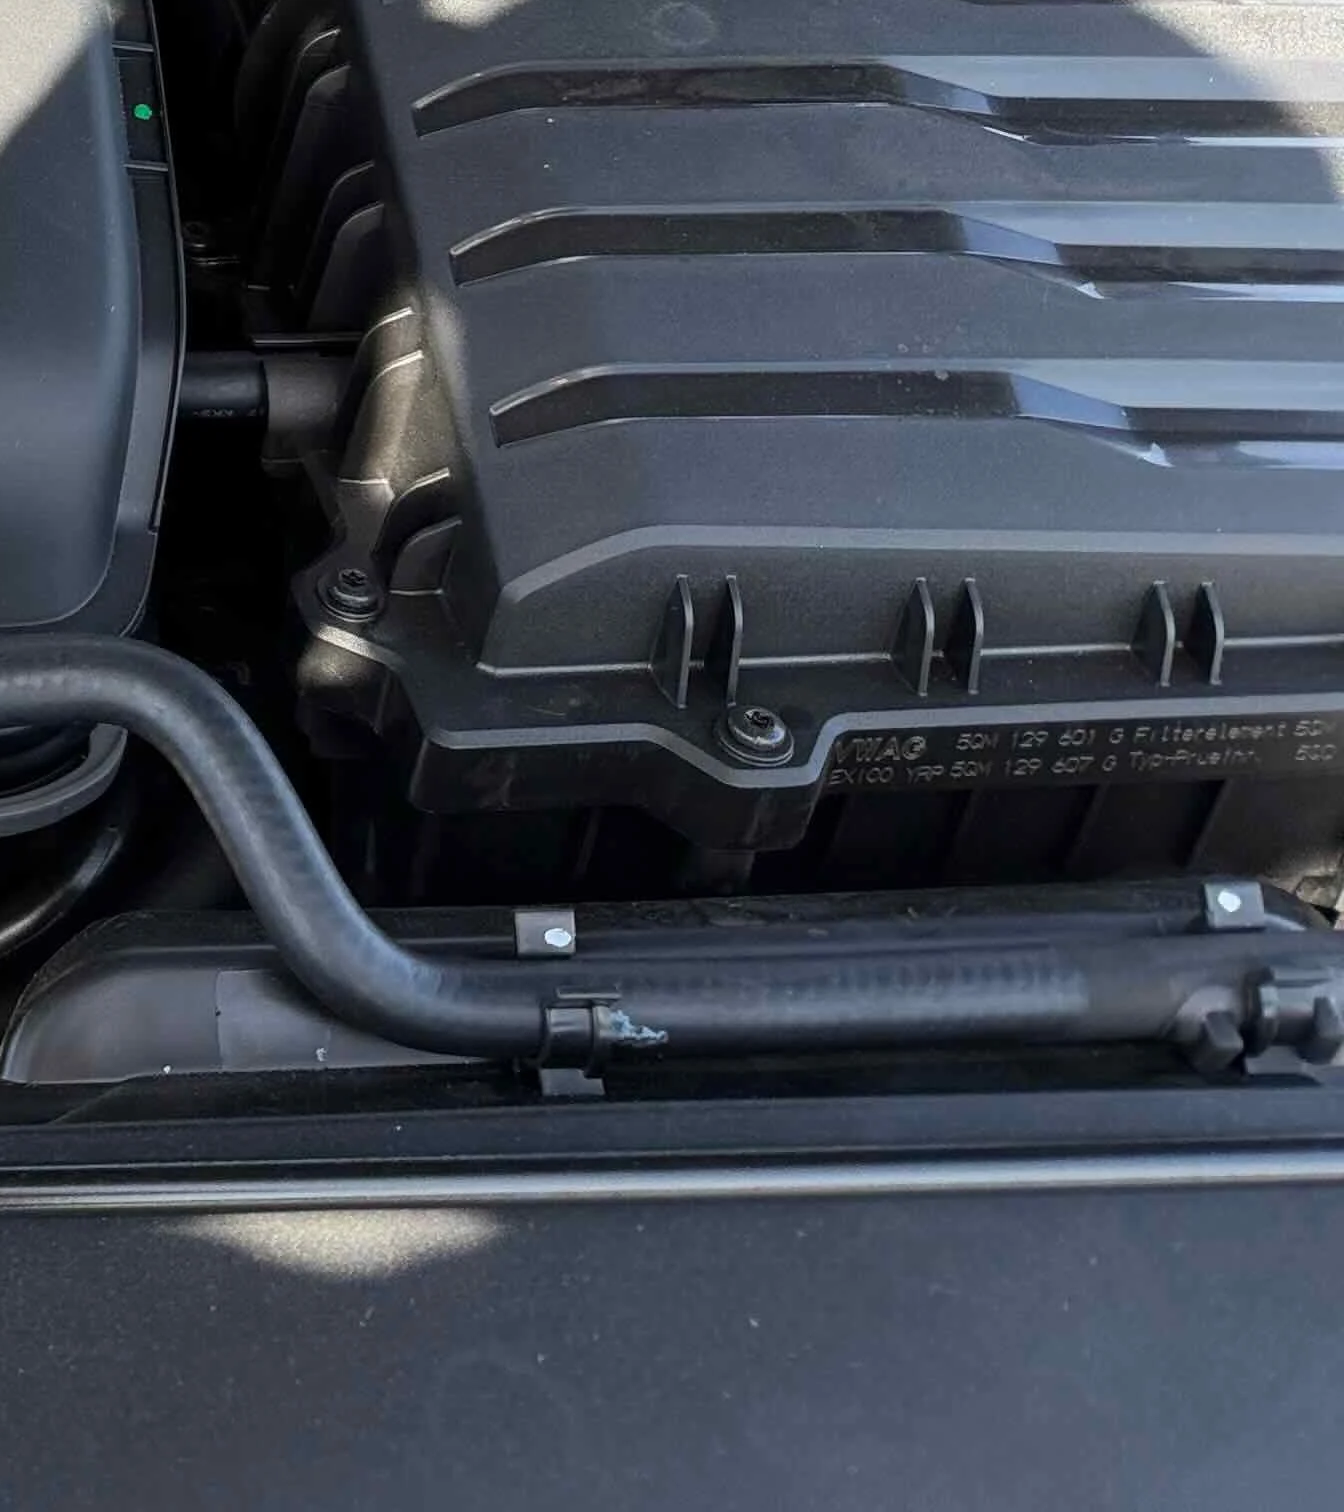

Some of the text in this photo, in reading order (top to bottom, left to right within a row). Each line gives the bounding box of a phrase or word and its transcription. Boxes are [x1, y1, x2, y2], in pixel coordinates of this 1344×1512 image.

[1012, 731, 1049, 748] 129
[1058, 728, 1095, 746] 601
[1004, 759, 1042, 776] 129
